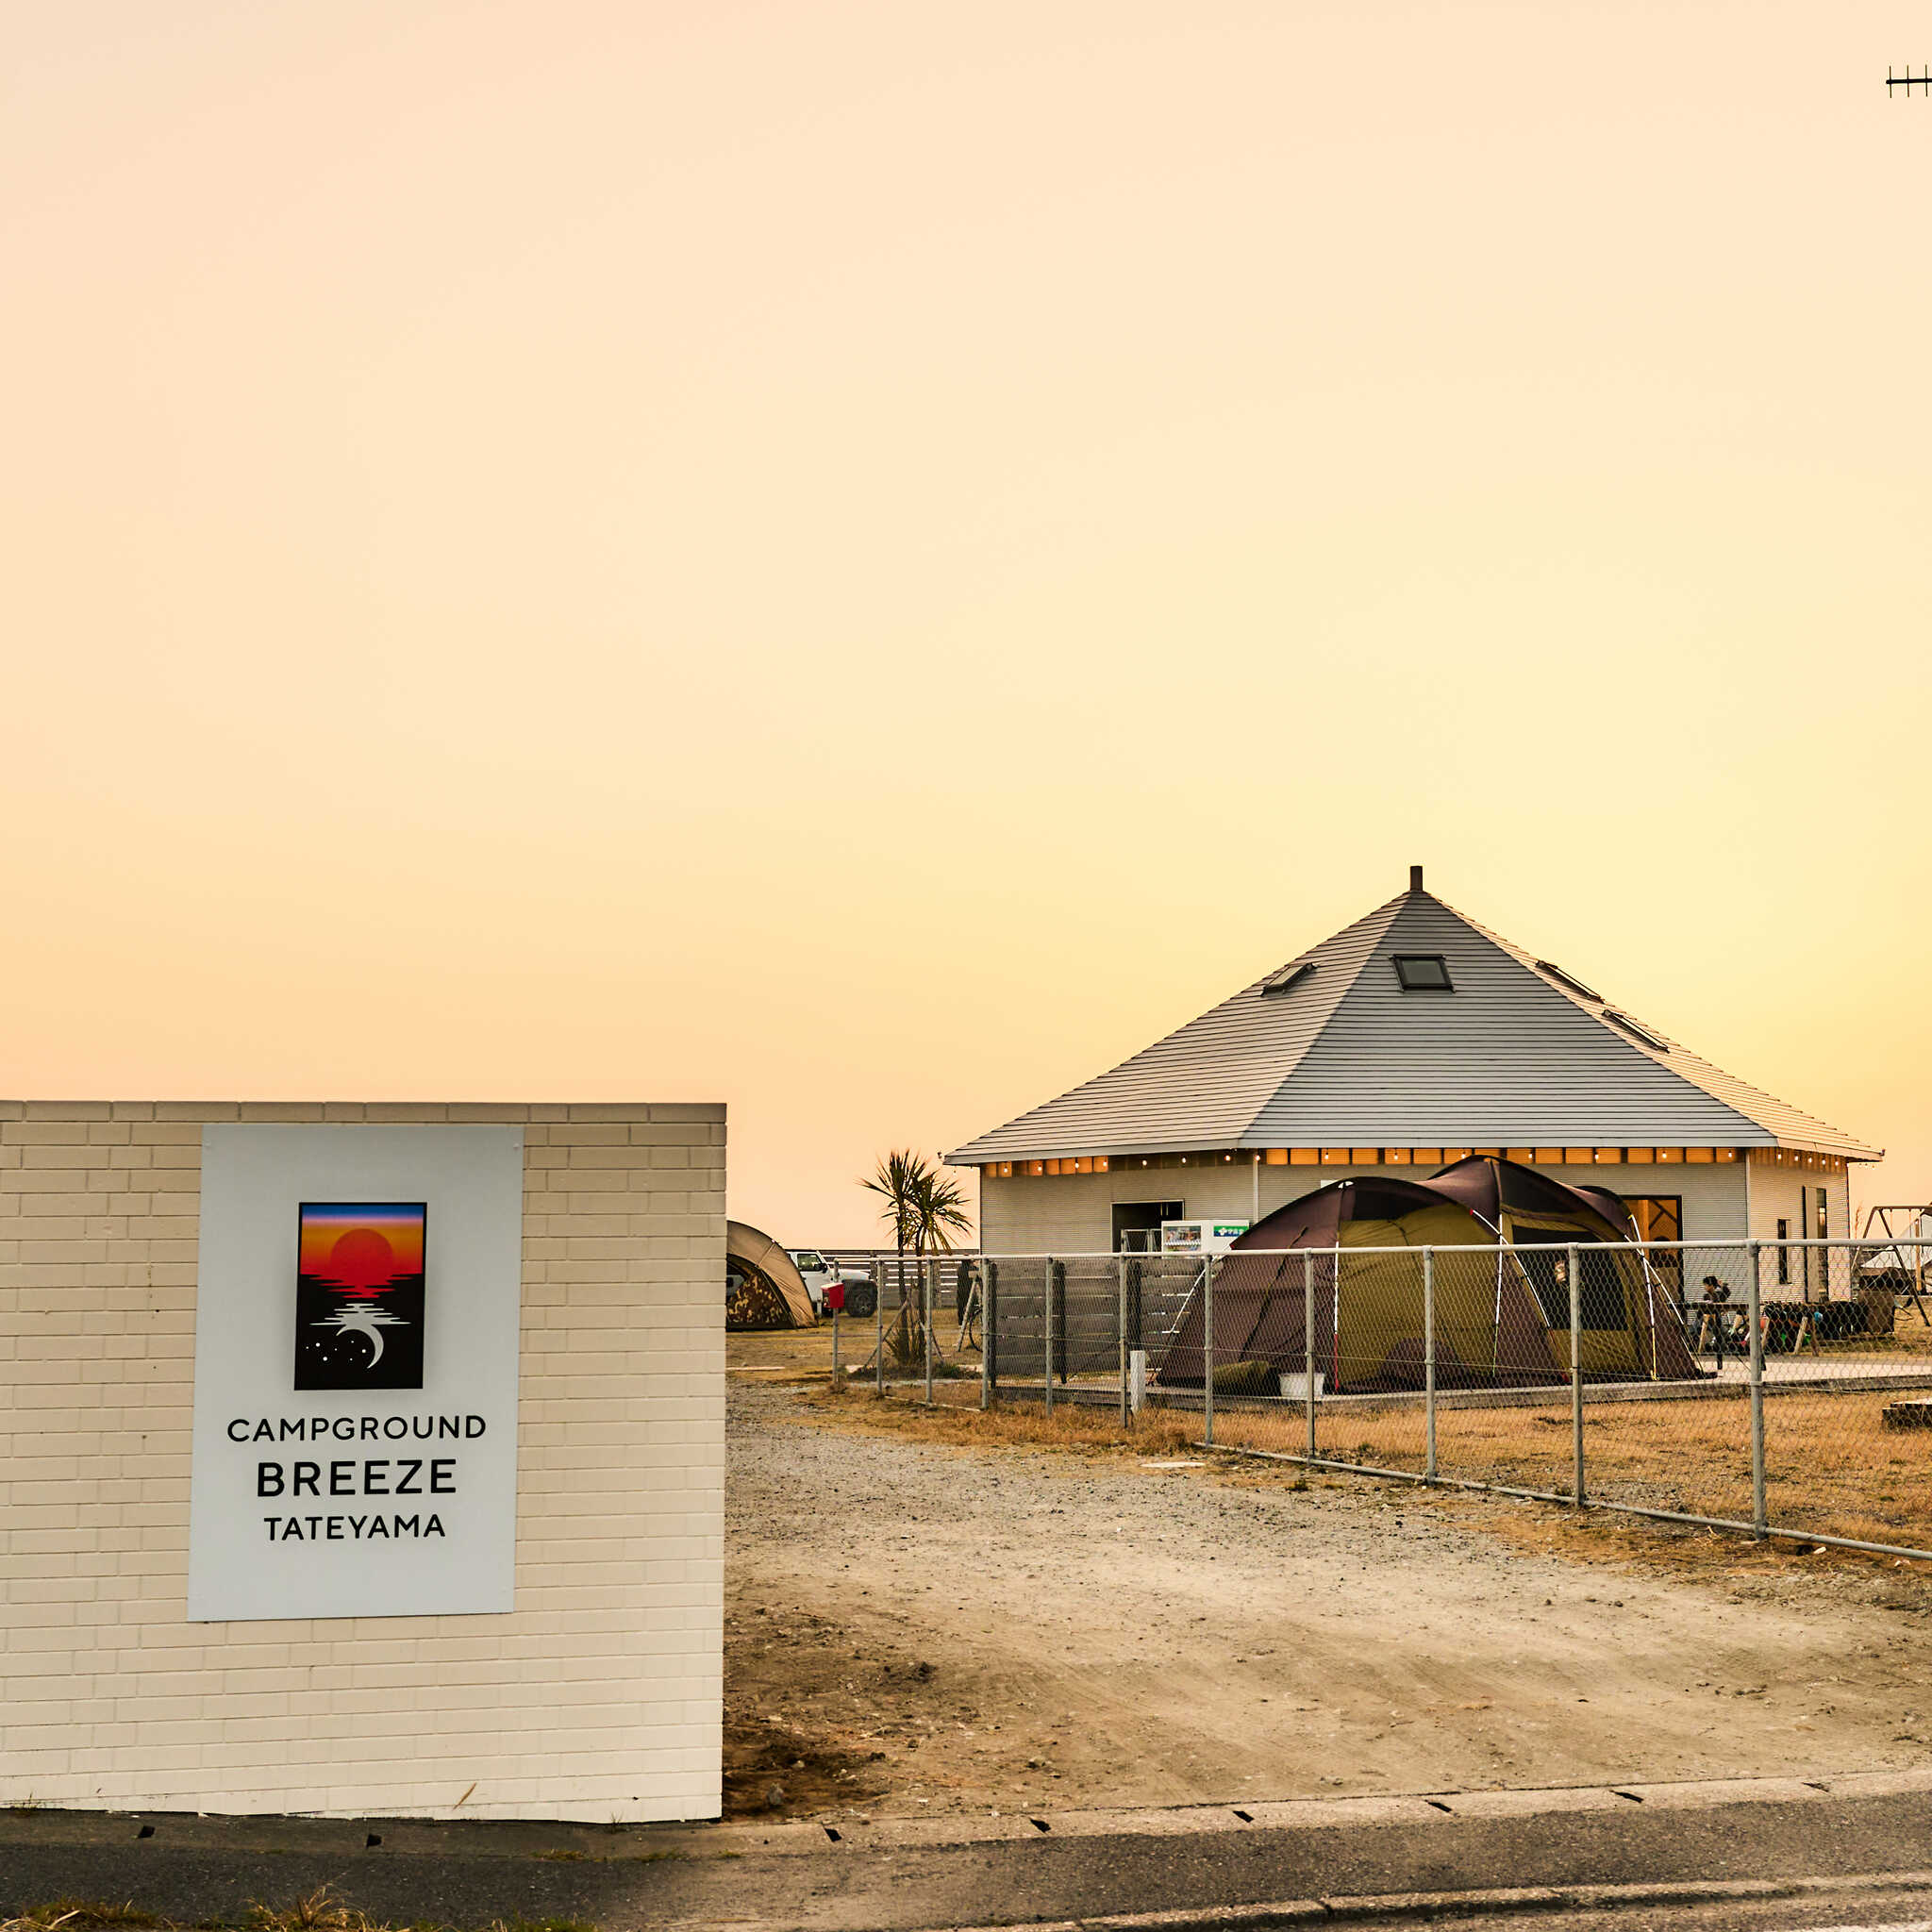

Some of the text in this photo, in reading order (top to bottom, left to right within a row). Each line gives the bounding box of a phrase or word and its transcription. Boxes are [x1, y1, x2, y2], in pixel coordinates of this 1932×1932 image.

[226, 1415, 486, 1442] CAMPGROUND
[257, 1458, 457, 1497] BREEZE
[264, 1514, 445, 1541] TATEYAMA
